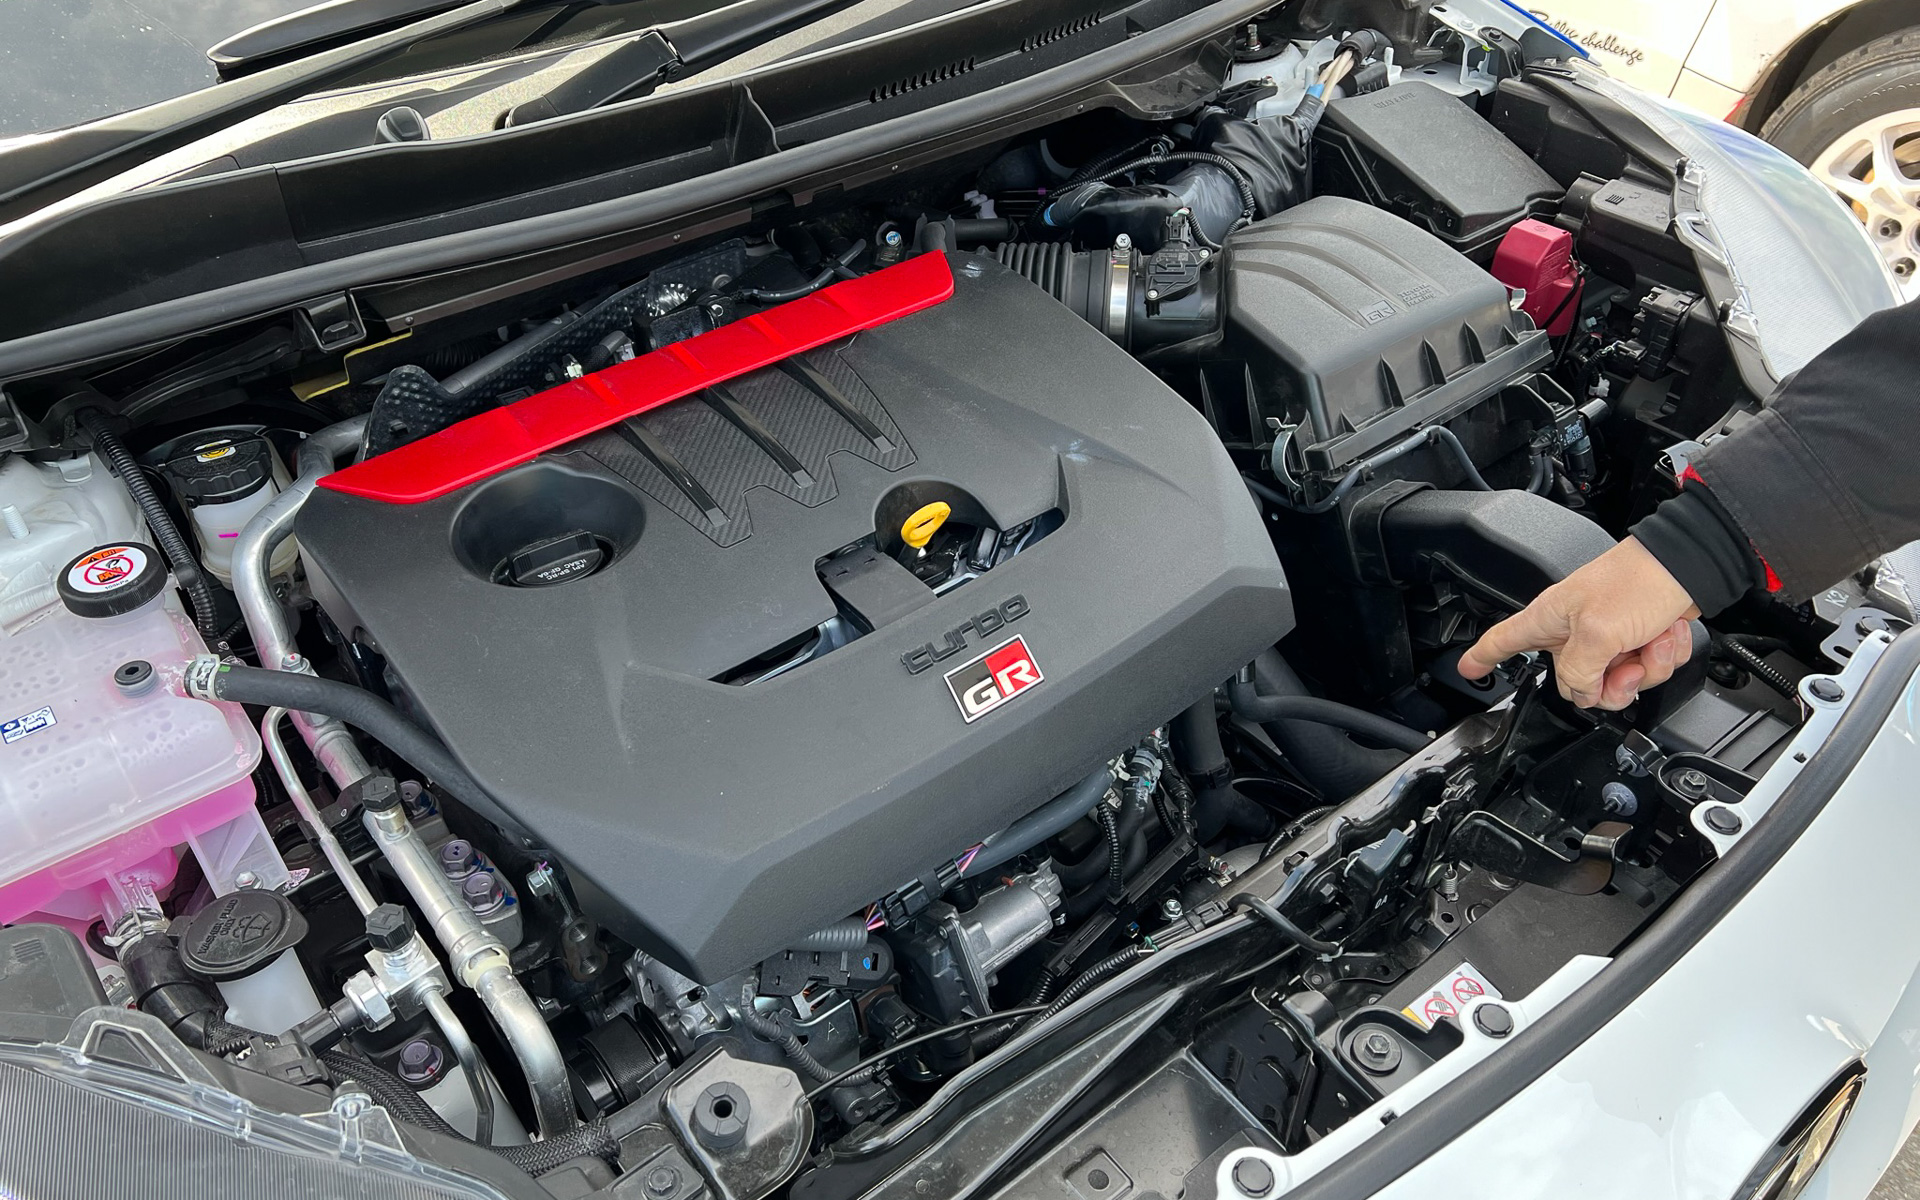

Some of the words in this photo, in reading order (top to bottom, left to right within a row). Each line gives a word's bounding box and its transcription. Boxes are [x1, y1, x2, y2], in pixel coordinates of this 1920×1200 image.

[1580, 31, 1644, 66] challenge
[1824, 589, 1850, 608] K2
[900, 593, 1031, 676] turbo
[962, 658, 1039, 715] GR
[197, 922, 225, 955] WASHER
[219, 899, 239, 920] FLUID
